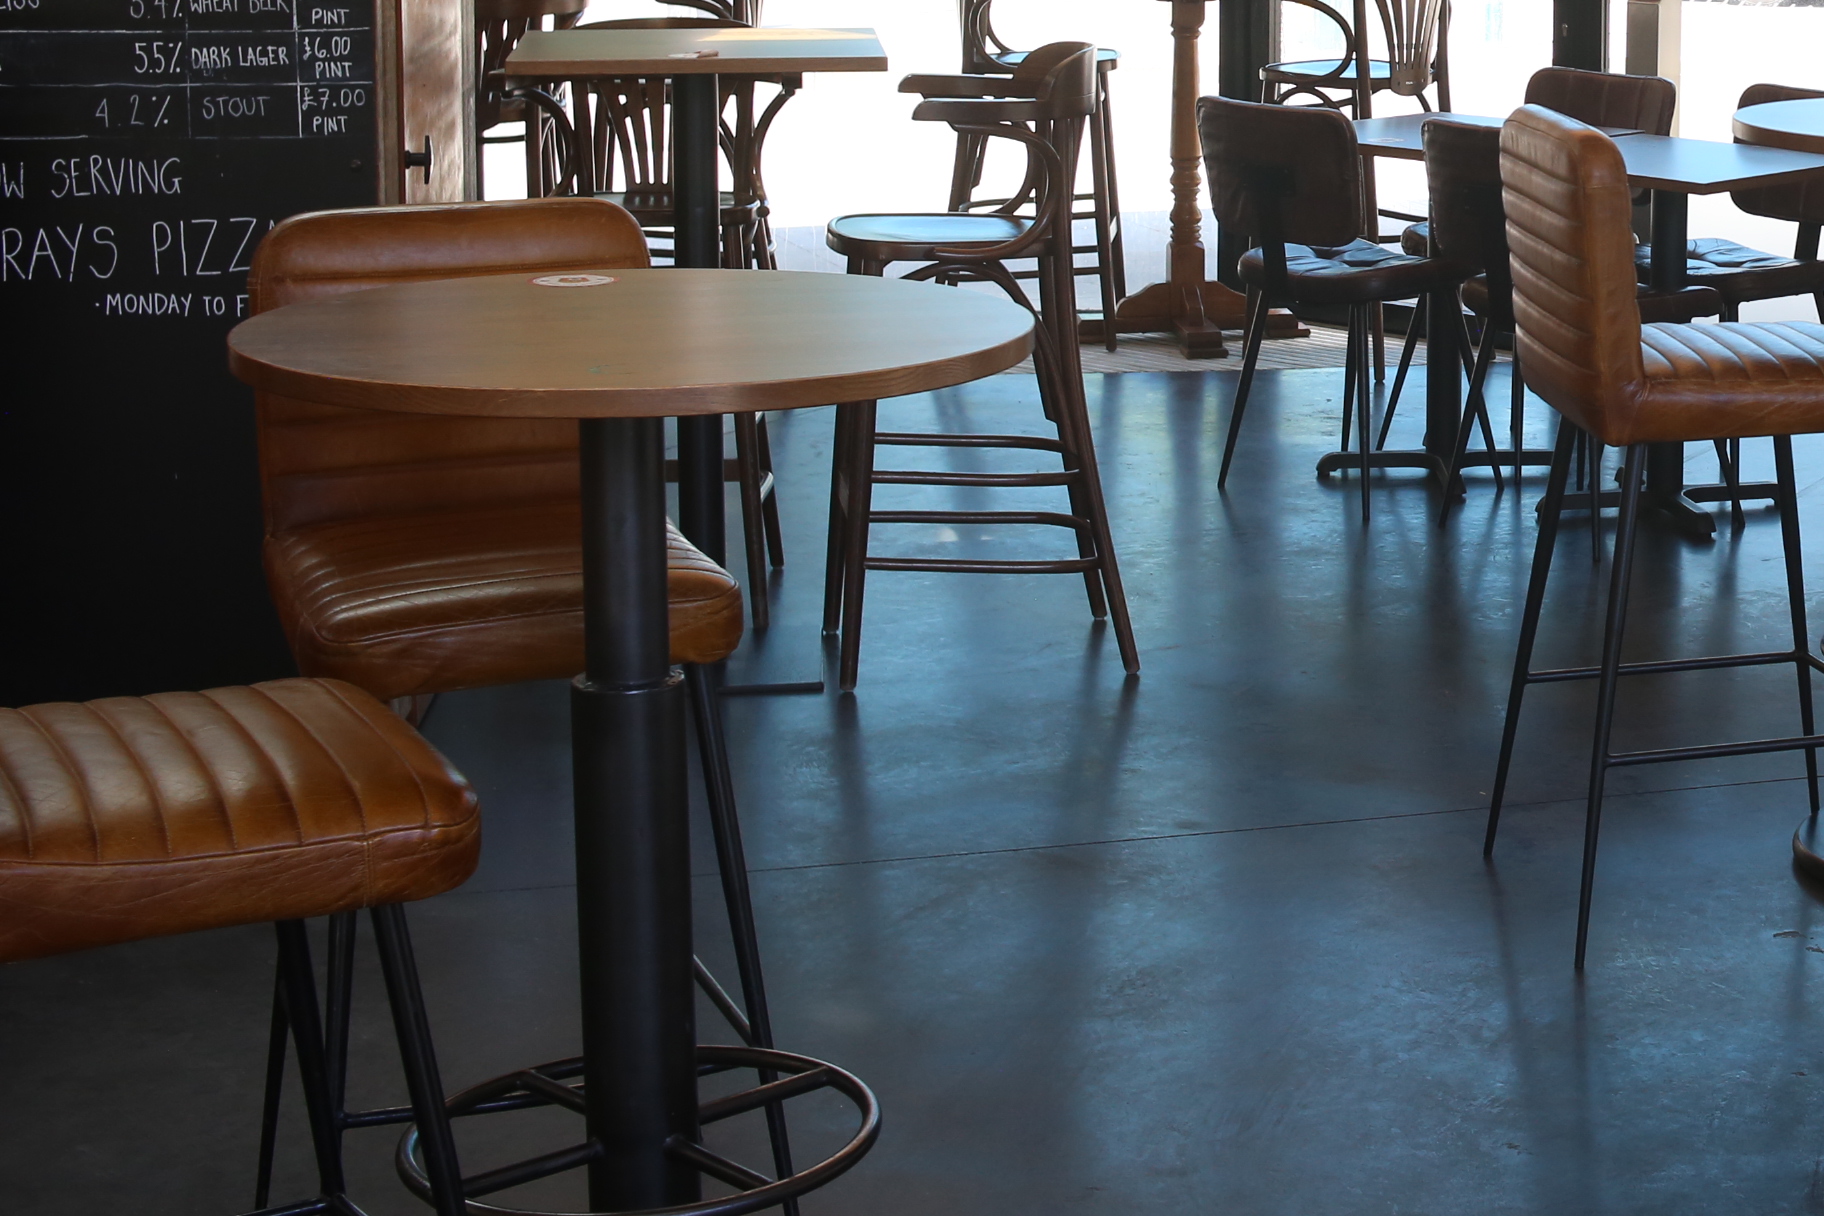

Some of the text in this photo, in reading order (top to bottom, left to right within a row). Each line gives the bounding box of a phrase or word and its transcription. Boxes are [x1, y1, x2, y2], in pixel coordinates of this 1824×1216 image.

[311, 7, 350, 26] PINT
[191, 45, 290, 70] DARK LAGER
[315, 61, 353, 80] PINT
[202, 95, 271, 120] STOUT
[313, 115, 349, 136] PINT
[51, 154, 183, 199] SERVING
[1, 217, 276, 282] RAYS PIZZ
[106, 292, 193, 317] MONDAY
[203, 294, 226, 317] TO
